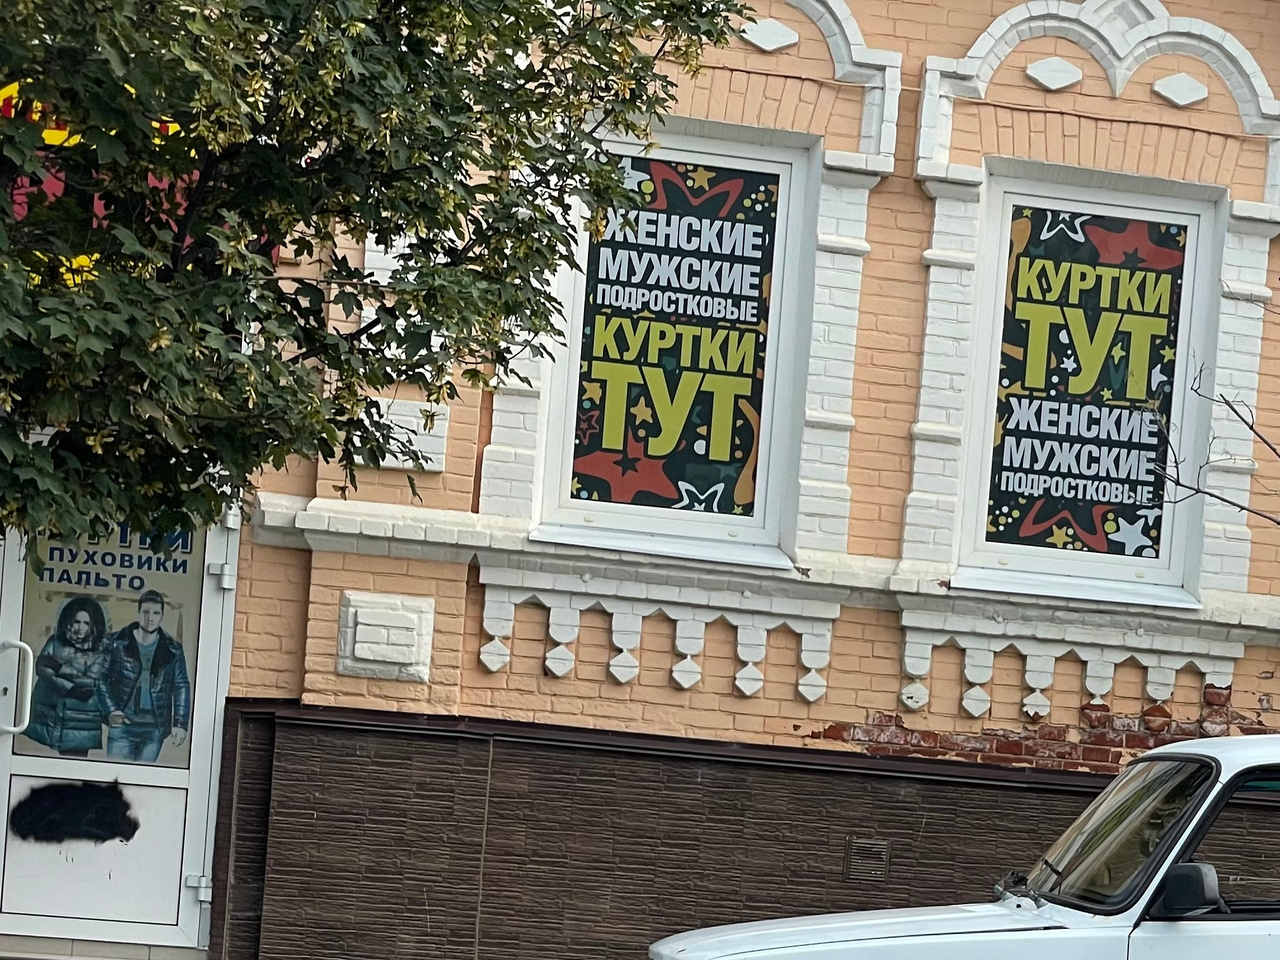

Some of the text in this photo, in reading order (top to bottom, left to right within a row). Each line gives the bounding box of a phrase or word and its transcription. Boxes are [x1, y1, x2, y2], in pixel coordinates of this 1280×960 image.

[601, 206, 764, 259] ЖЕНСКИЕ
[598, 246, 760, 298] МУЖСКИЕ
[1016, 256, 1172, 315] КУРТКИ
[596, 282, 758, 323] ПОДРОСТКОВЫЕ
[592, 314, 756, 375] КУРТКИ
[1014, 301, 1168, 401] ТУТ
[591, 360, 753, 462] ТУТ
[1006, 396, 1159, 445] ЖЕНСКИЕ
[1002, 435, 1156, 482] МУЖСКИЕ
[1000, 471, 1154, 506] ПОДРОСТКОВЫЕ
[39, 567, 146, 591] ПАЛЬТО
[49, 546, 188, 574] ПУХОВИКИ
